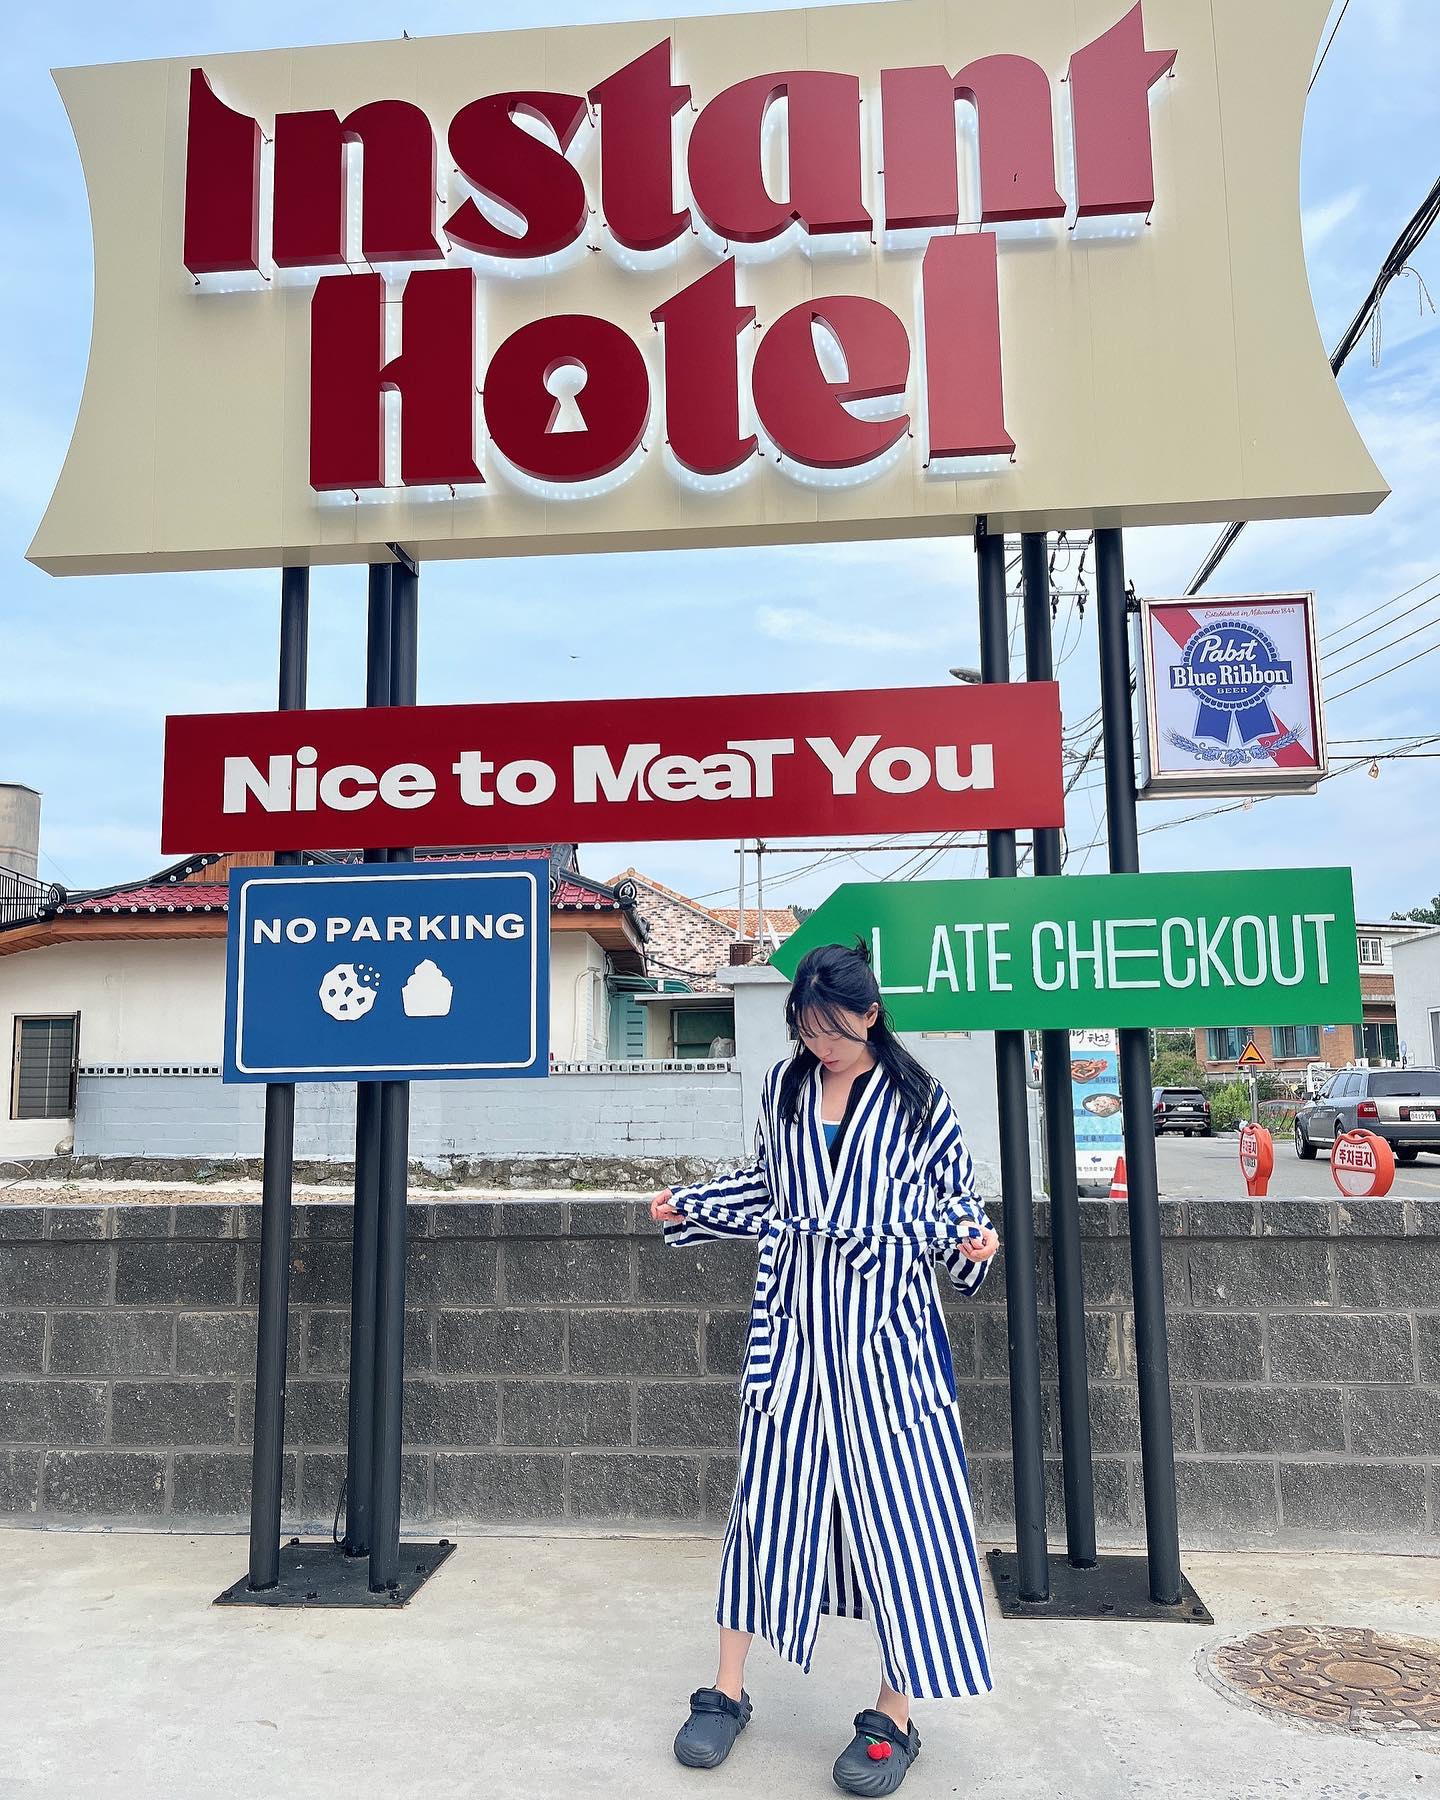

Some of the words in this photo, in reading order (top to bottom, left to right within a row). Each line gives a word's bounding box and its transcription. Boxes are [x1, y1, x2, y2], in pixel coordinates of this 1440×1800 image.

[183, 2, 1177, 274] Instant
[309, 233, 1016, 492] Hotel
[1172, 666, 1217, 687] Blue
[1219, 663, 1290, 685] Ribbon
[1198, 634, 1258, 662] Pabst
[223, 746, 437, 814] Nice
[452, 750, 556, 806] to
[805, 734, 995, 795] You
[253, 917, 317, 944] NO
[326, 913, 525, 942] PARKING
[871, 922, 1013, 995] LATE
[1031, 913, 1336, 991] CHECKOUT
[1339, 1148, 1373, 1168] 주차금지
